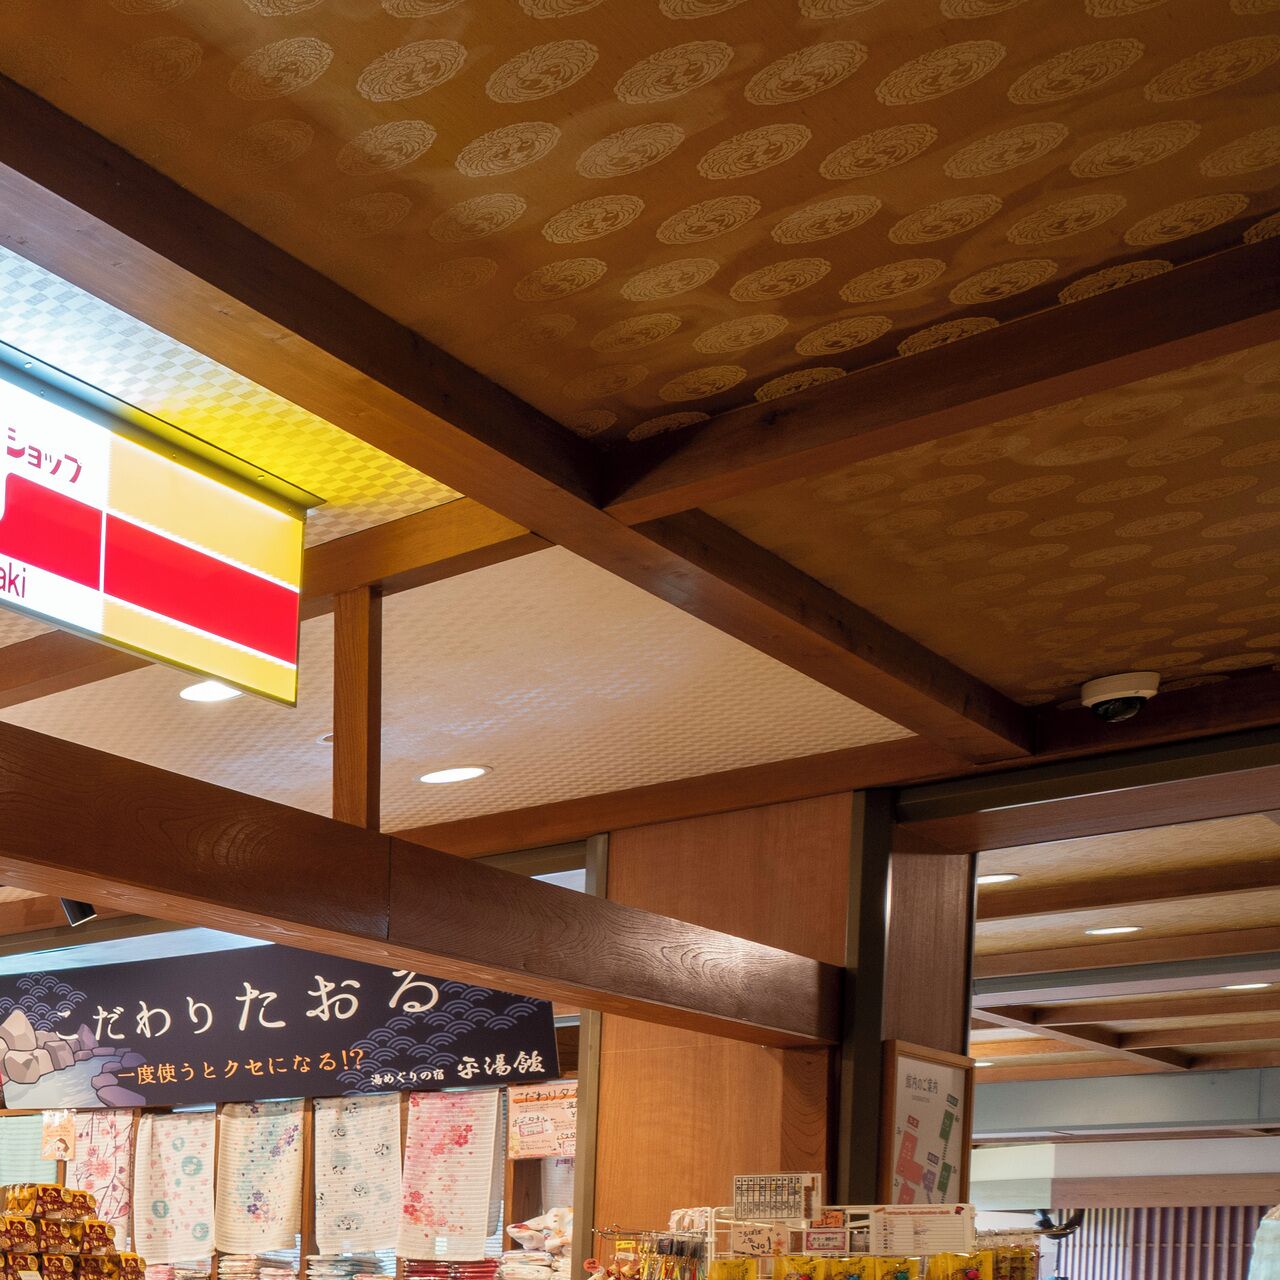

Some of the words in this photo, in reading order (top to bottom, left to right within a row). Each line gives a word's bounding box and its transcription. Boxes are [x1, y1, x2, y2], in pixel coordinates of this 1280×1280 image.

[6, 426, 84, 485] ショップ
[54, 968, 441, 1042] こだわりたおる
